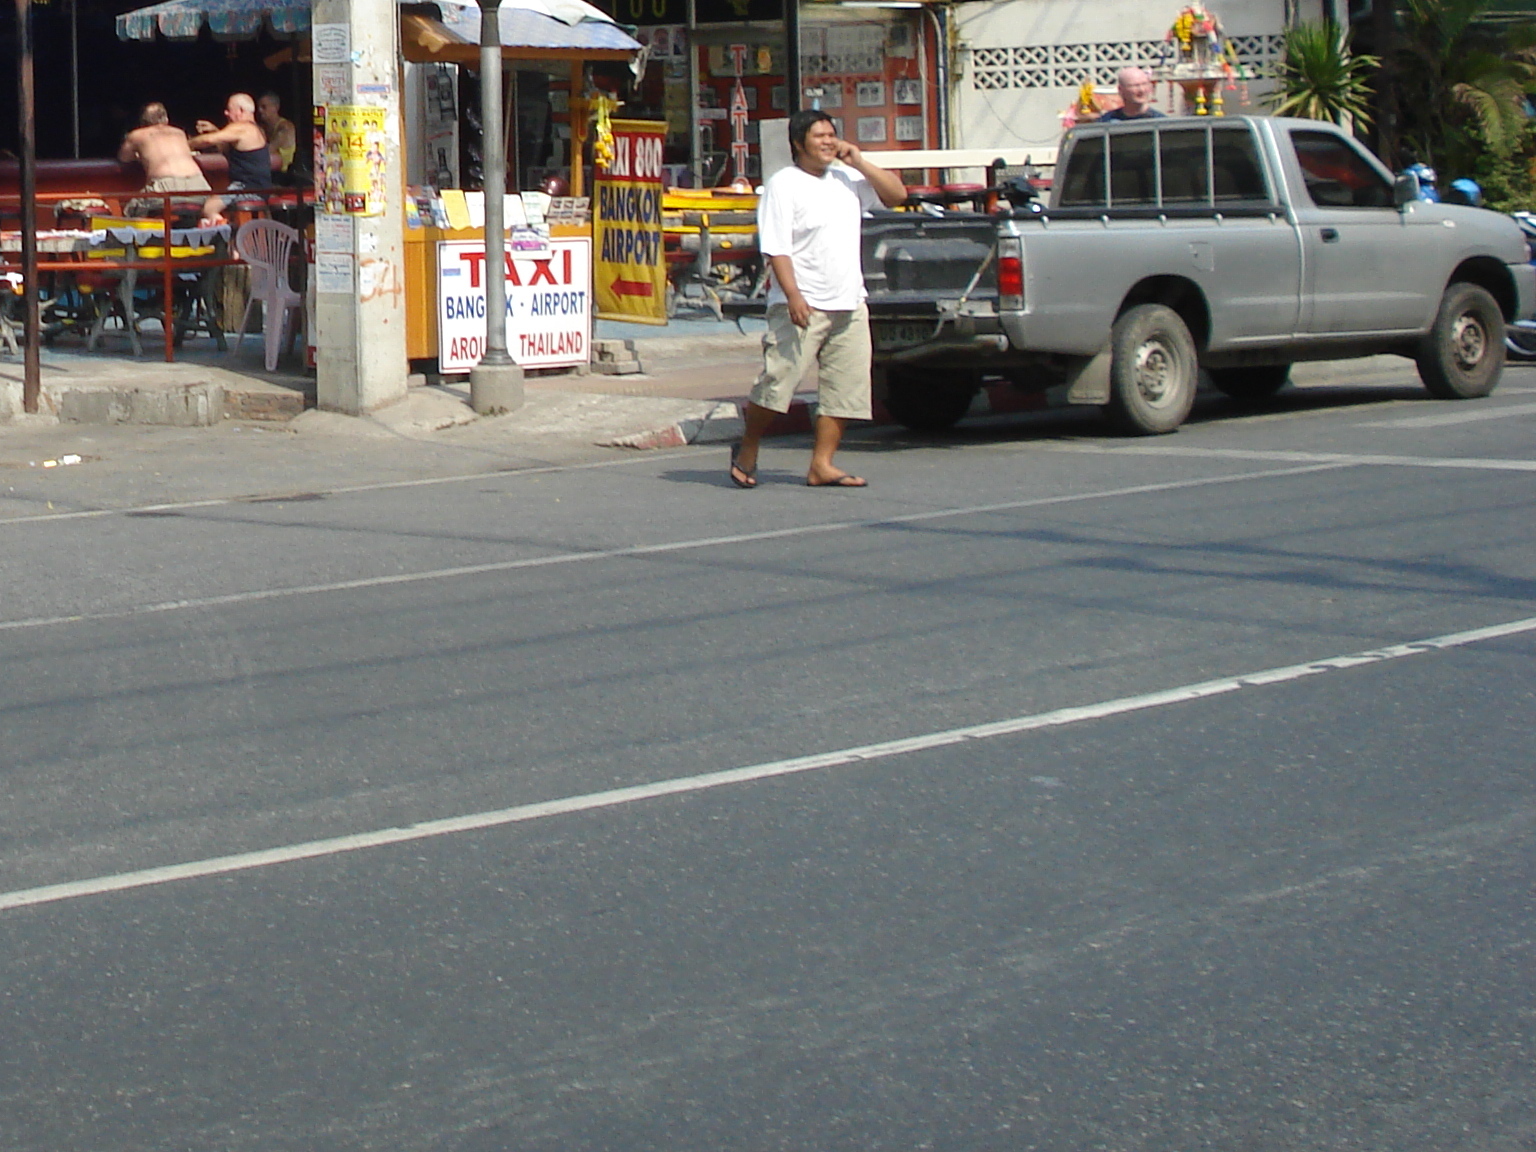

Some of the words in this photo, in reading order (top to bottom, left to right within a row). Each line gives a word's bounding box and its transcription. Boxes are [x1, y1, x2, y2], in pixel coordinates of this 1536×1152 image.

[635, 137, 663, 178] 800
[599, 185, 661, 224] BANGKOK
[601, 227, 661, 266] AIRPORT
[446, 294, 514, 319] BANGK
[530, 291, 585, 317] AIRPORT
[450, 336, 487, 361] AROU
[519, 331, 583, 357] THAILAND
